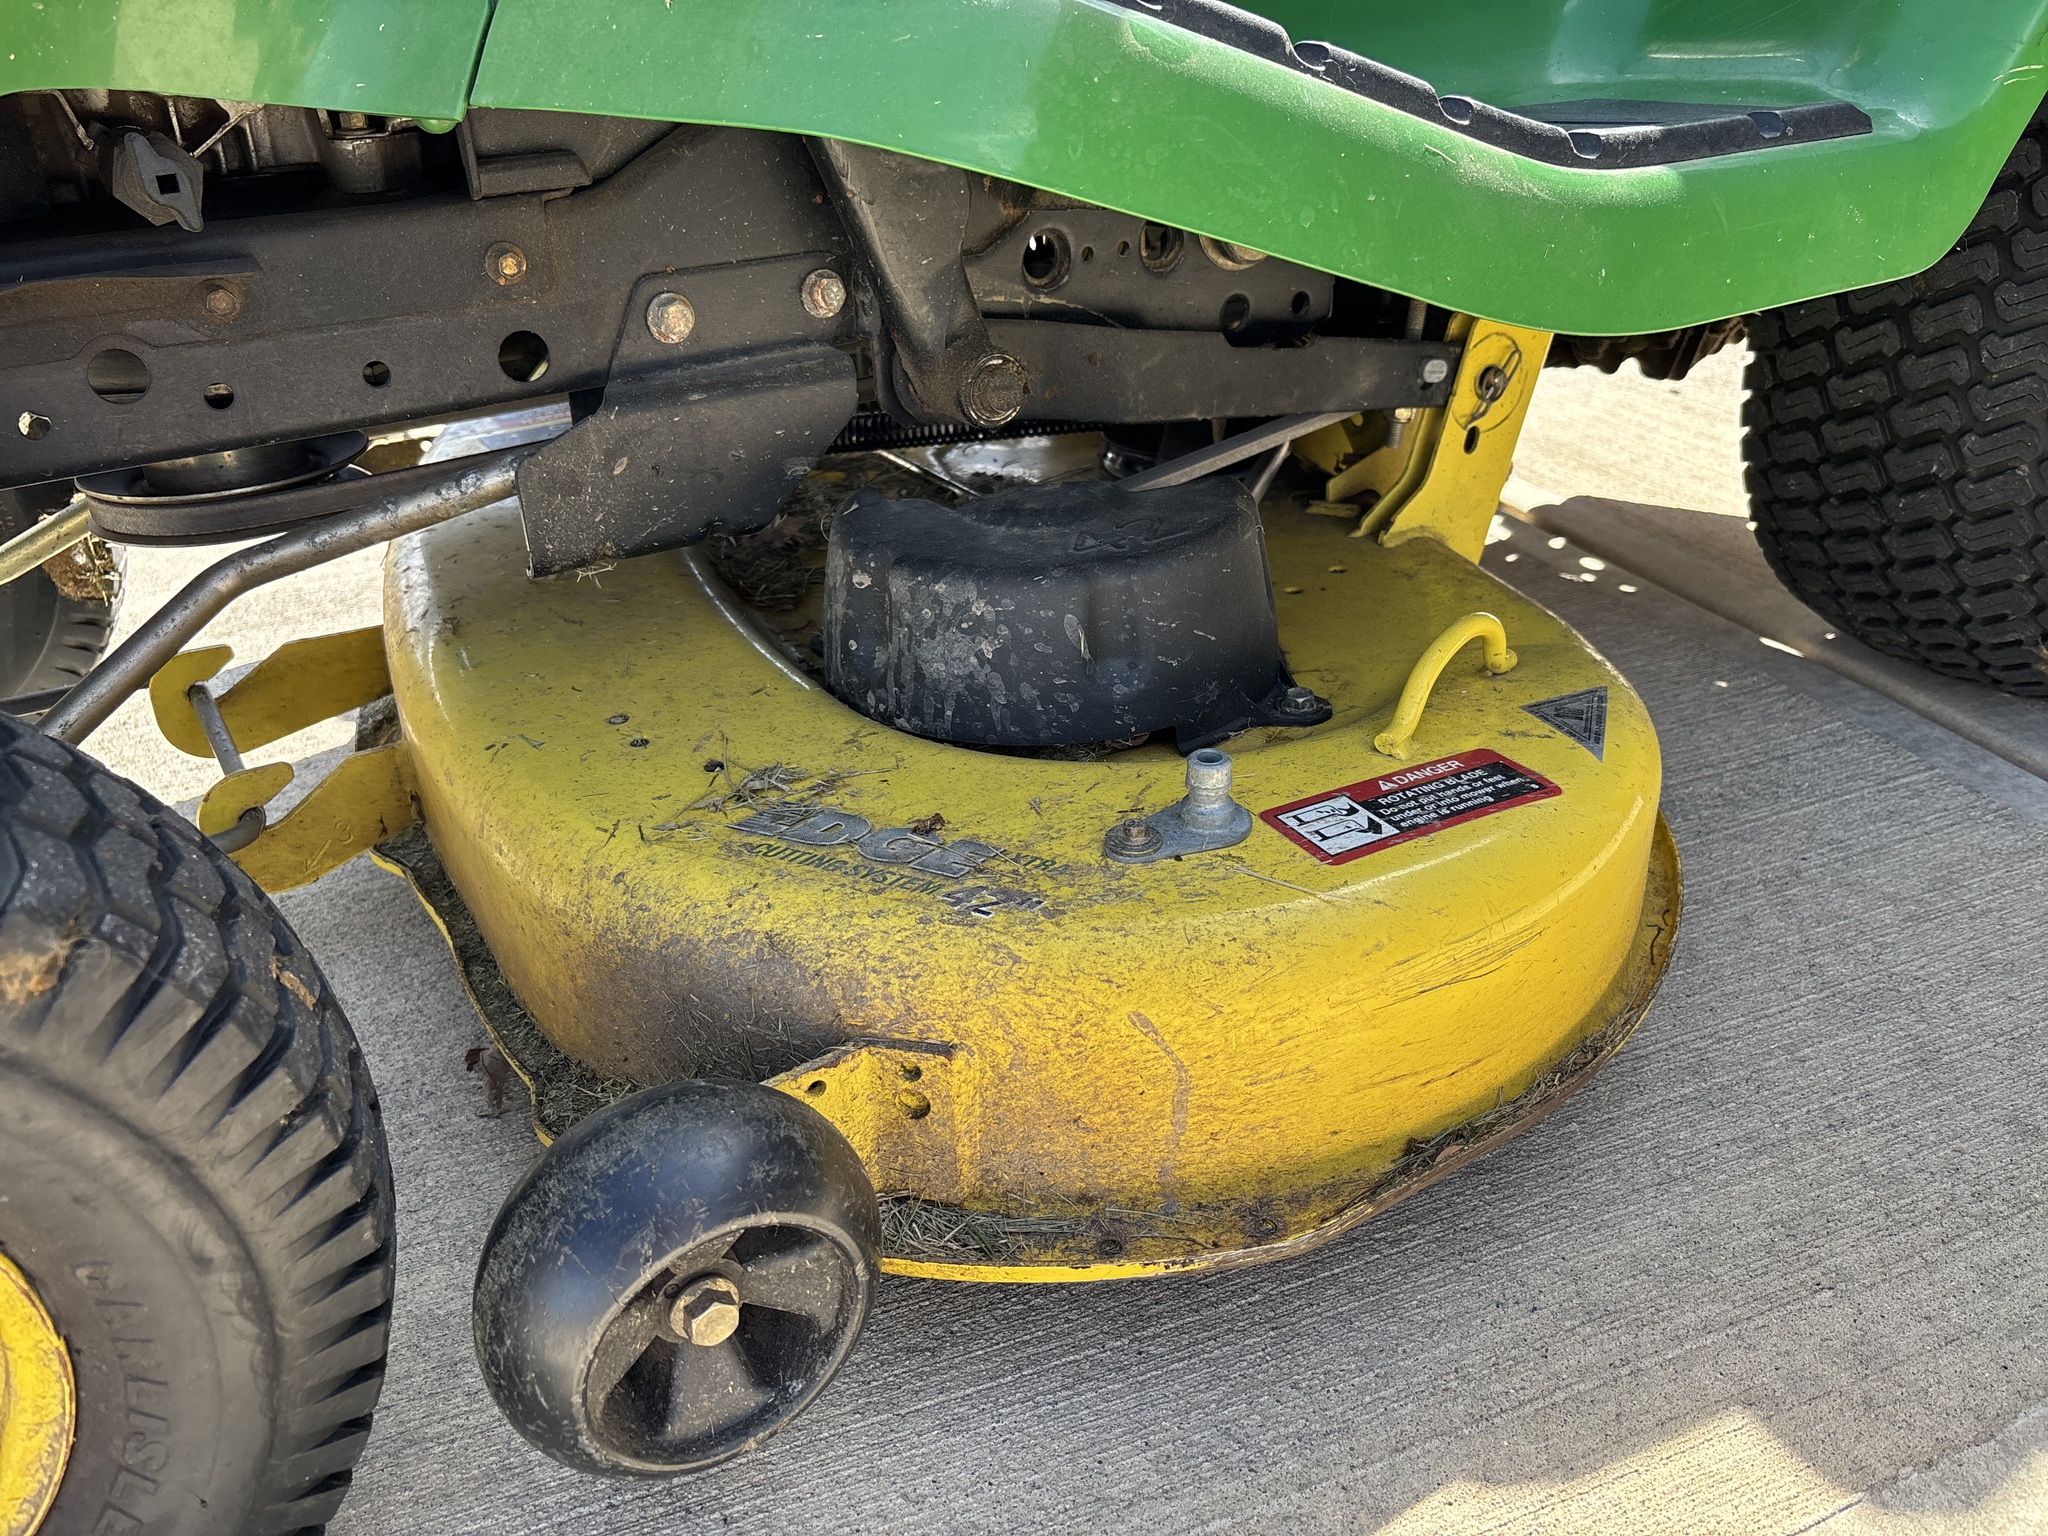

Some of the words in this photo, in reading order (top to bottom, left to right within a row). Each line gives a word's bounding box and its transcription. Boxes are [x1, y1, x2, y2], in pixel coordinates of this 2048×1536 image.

[1377, 781, 1445, 806] ROTATING
[1444, 769, 1489, 786] BLADE
[1392, 760, 1465, 785] DANGER
[1379, 806, 1397, 816] Do
[1396, 800, 1419, 811] not
[1419, 794, 1439, 806] put
[1438, 785, 1472, 799] hands
[1472, 780, 1484, 788] or
[1482, 774, 1506, 785] feet
[1390, 808, 1423, 822] under
[1424, 802, 1438, 812] or
[1437, 796, 1459, 807] into
[1460, 786, 1496, 801] mower
[1495, 777, 1525, 790] when
[1399, 812, 1438, 828] engine
[1439, 806, 1451, 816] is
[1449, 795, 1495, 813] running
[752, 842, 846, 873] CUTTING
[844, 864, 945, 895] SYSTEM
